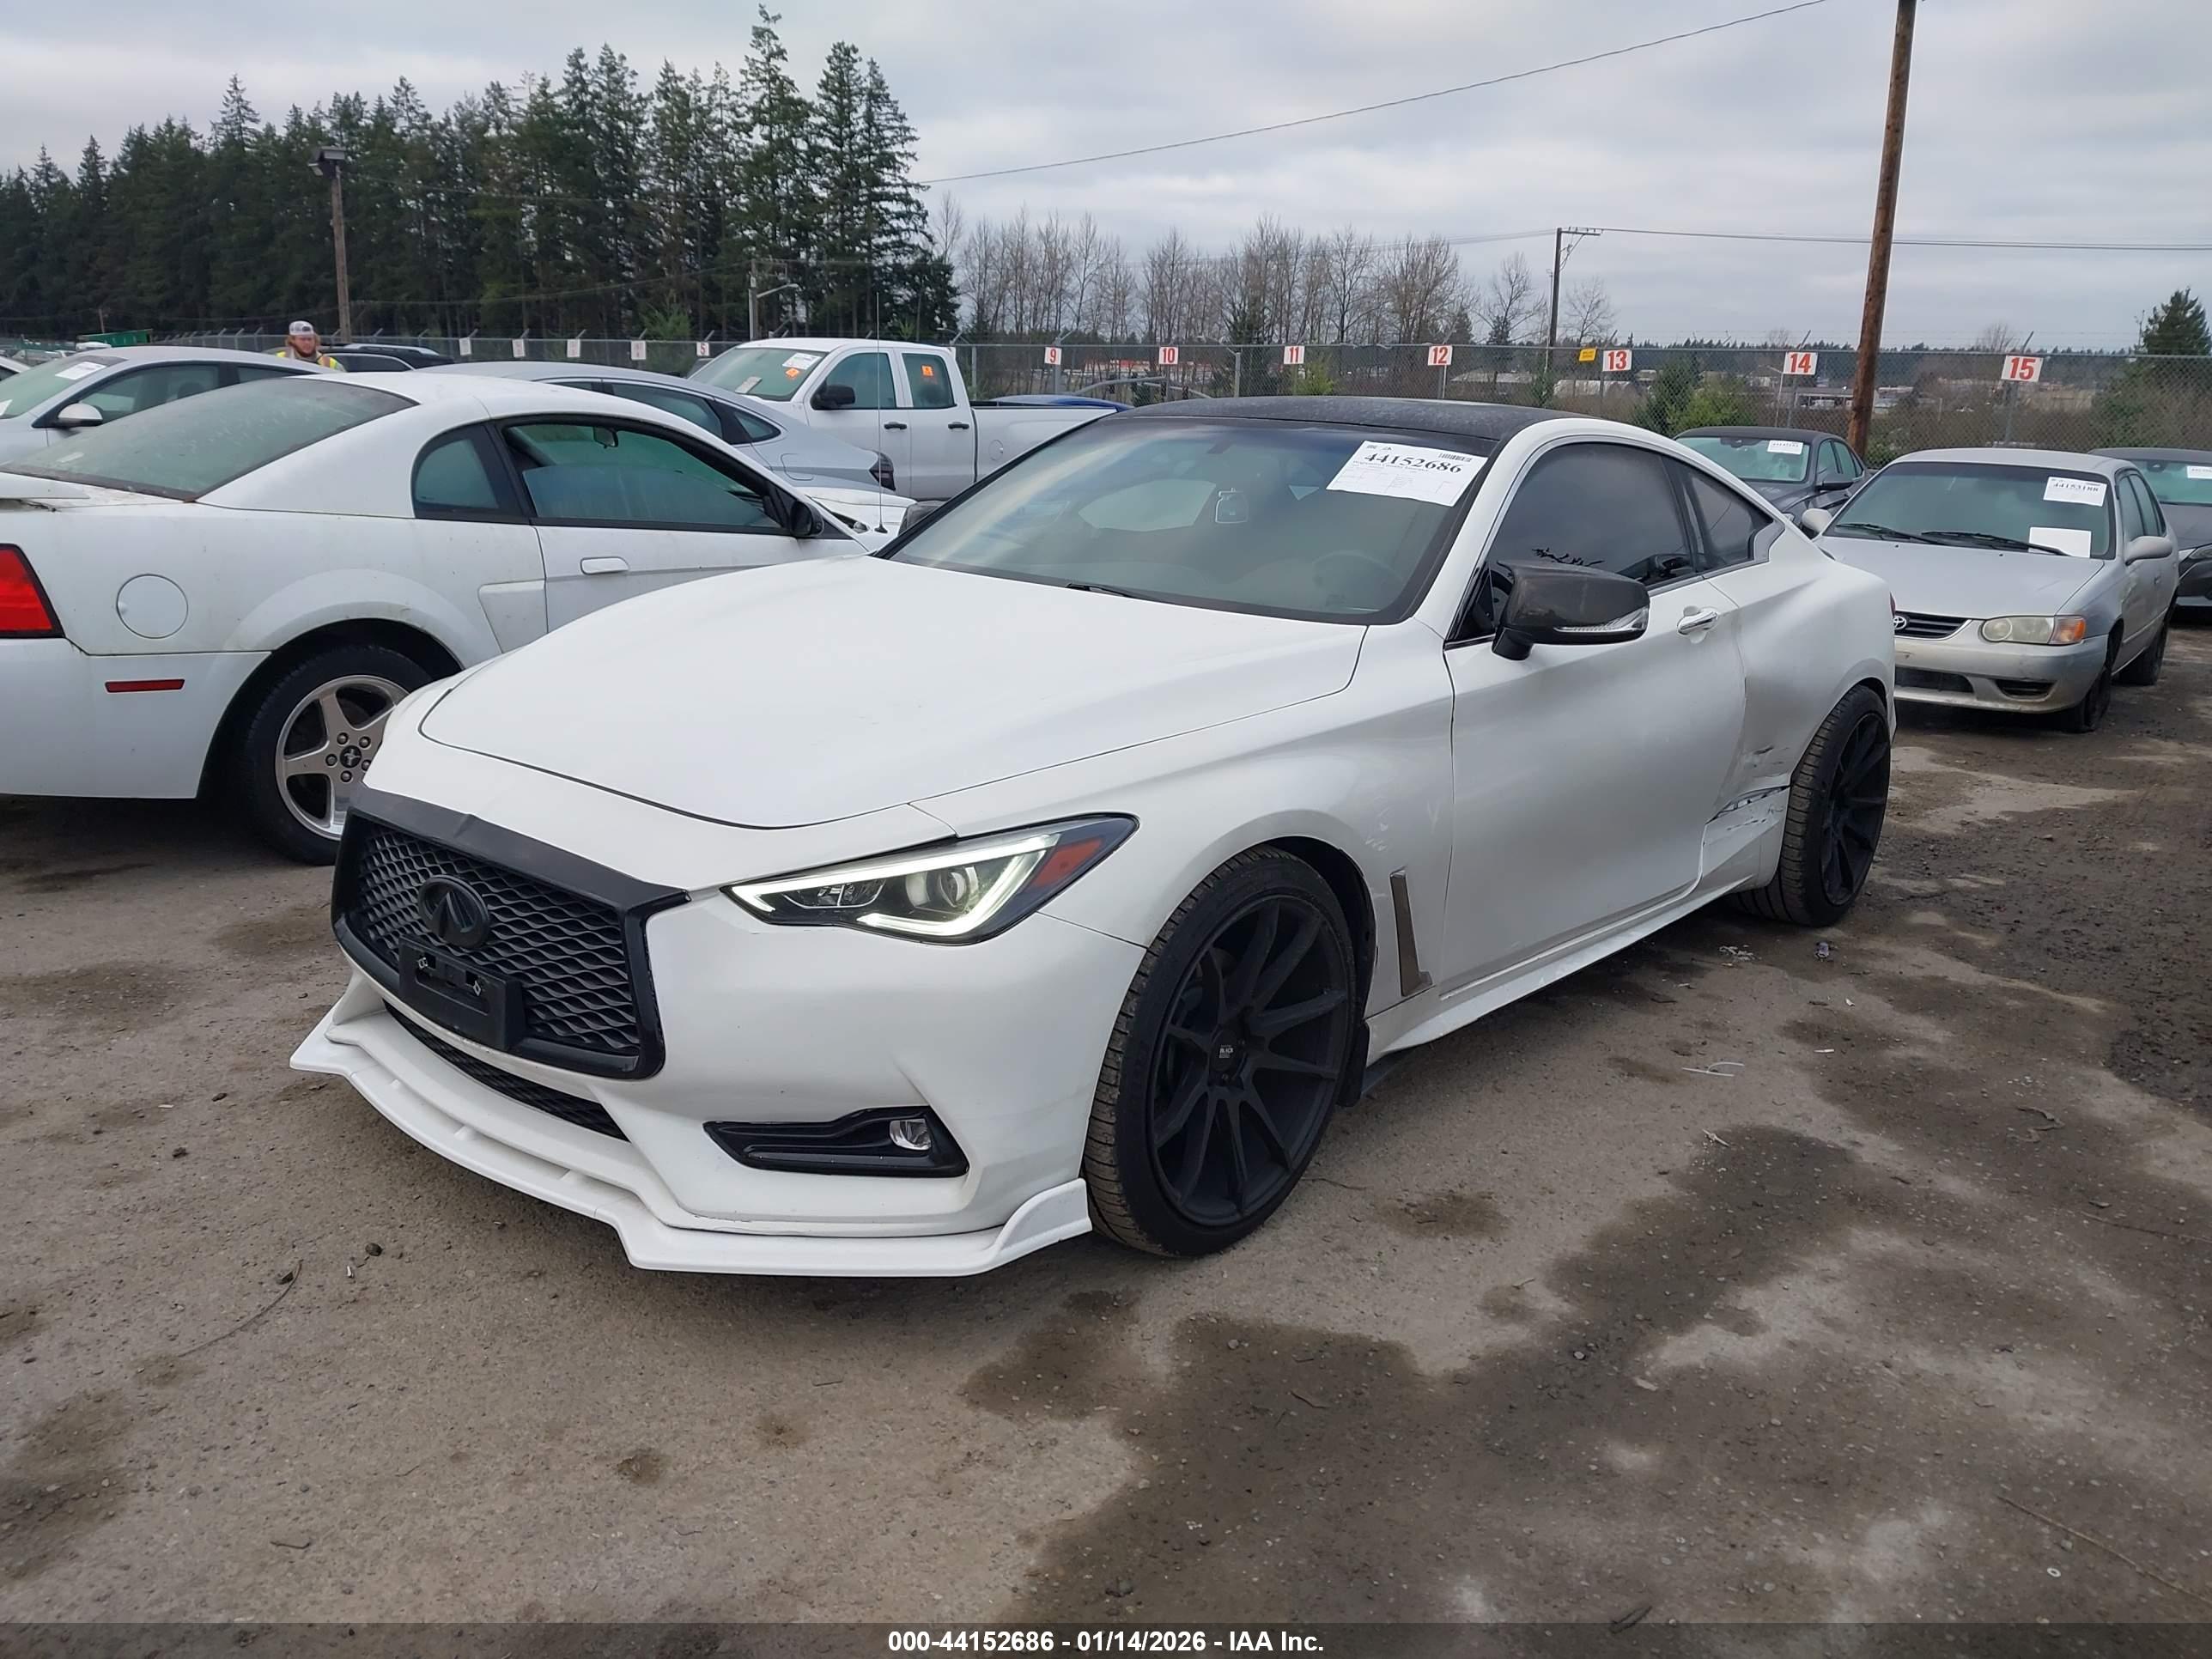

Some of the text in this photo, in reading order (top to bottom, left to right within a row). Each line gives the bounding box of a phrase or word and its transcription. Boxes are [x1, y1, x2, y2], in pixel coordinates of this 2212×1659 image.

[1049, 349, 1056, 363] 9
[1163, 348, 1176, 363] 10
[1289, 346, 1299, 362] 11
[1432, 346, 1449, 364] 12
[1607, 350, 1627, 370] 13
[1790, 353, 1811, 373] 14
[2009, 356, 2036, 380] 15
[1364, 453, 1463, 473] 44152686
